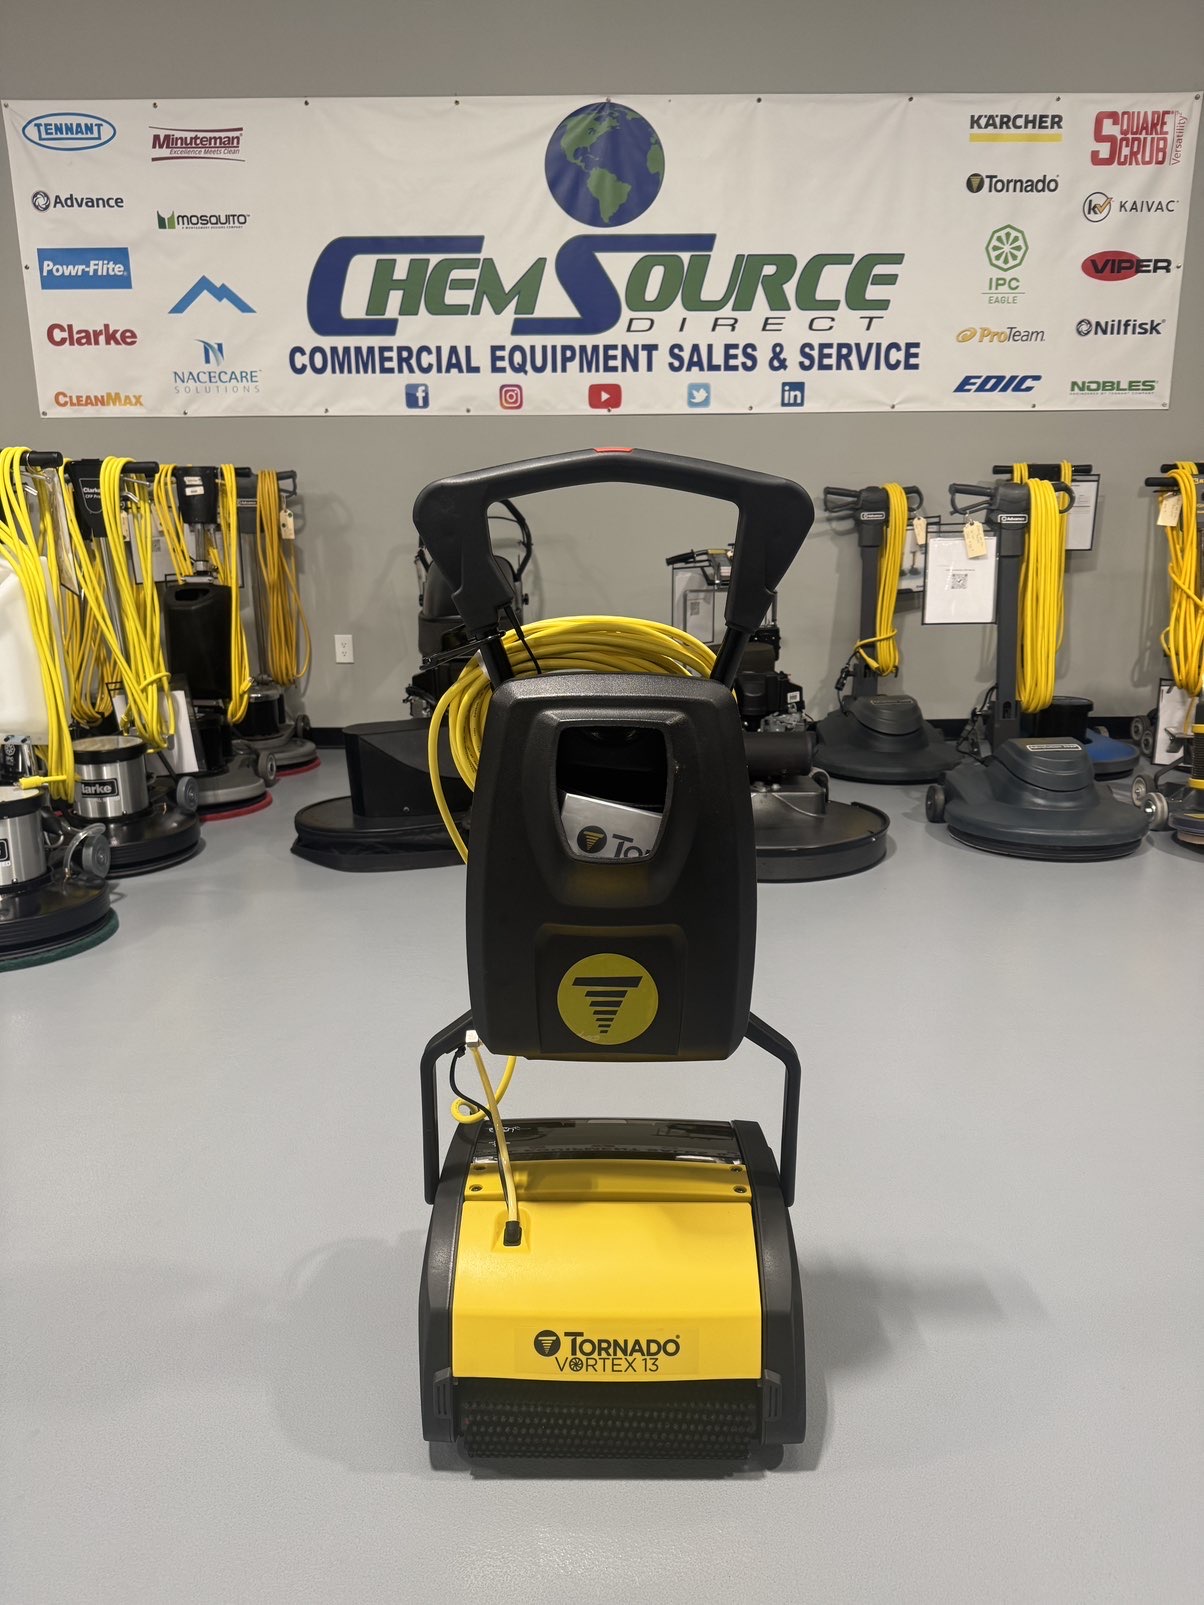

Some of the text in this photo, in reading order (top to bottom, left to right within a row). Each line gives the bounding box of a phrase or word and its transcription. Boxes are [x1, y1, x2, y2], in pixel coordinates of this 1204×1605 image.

[970, 113, 1063, 130] KÄRCHER
[34, 122, 103, 140] TENNANT
[152, 133, 241, 149] Minuteman
[985, 174, 1059, 193] Tornado
[53, 193, 124, 208] Advance
[1119, 200, 1175, 213] KAIVAC
[42, 260, 125, 276] Powr-Flite
[1090, 258, 1172, 274] VIPER
[988, 277, 1020, 291] IPC
[988, 295, 1018, 304] EAGLE
[626, 316, 885, 333] DIRECT
[1094, 319, 1163, 336] Nilfisk
[46, 323, 138, 347] Clarke
[979, 326, 1046, 343] ProTeam
[288, 342, 921, 376] COMMERCIAL EQUIPMENT SALES & SERVICE
[173, 370, 259, 384] NACECARE
[952, 374, 1043, 393] EDIC
[174, 385, 261, 394] SOLUTIONS
[1070, 379, 1157, 392] NOBLES
[81, 783, 112, 794] larke
[612, 833, 651, 858] To
[564, 1331, 680, 1357] TORNADO
[554, 1357, 659, 1373] VORTEX 13
